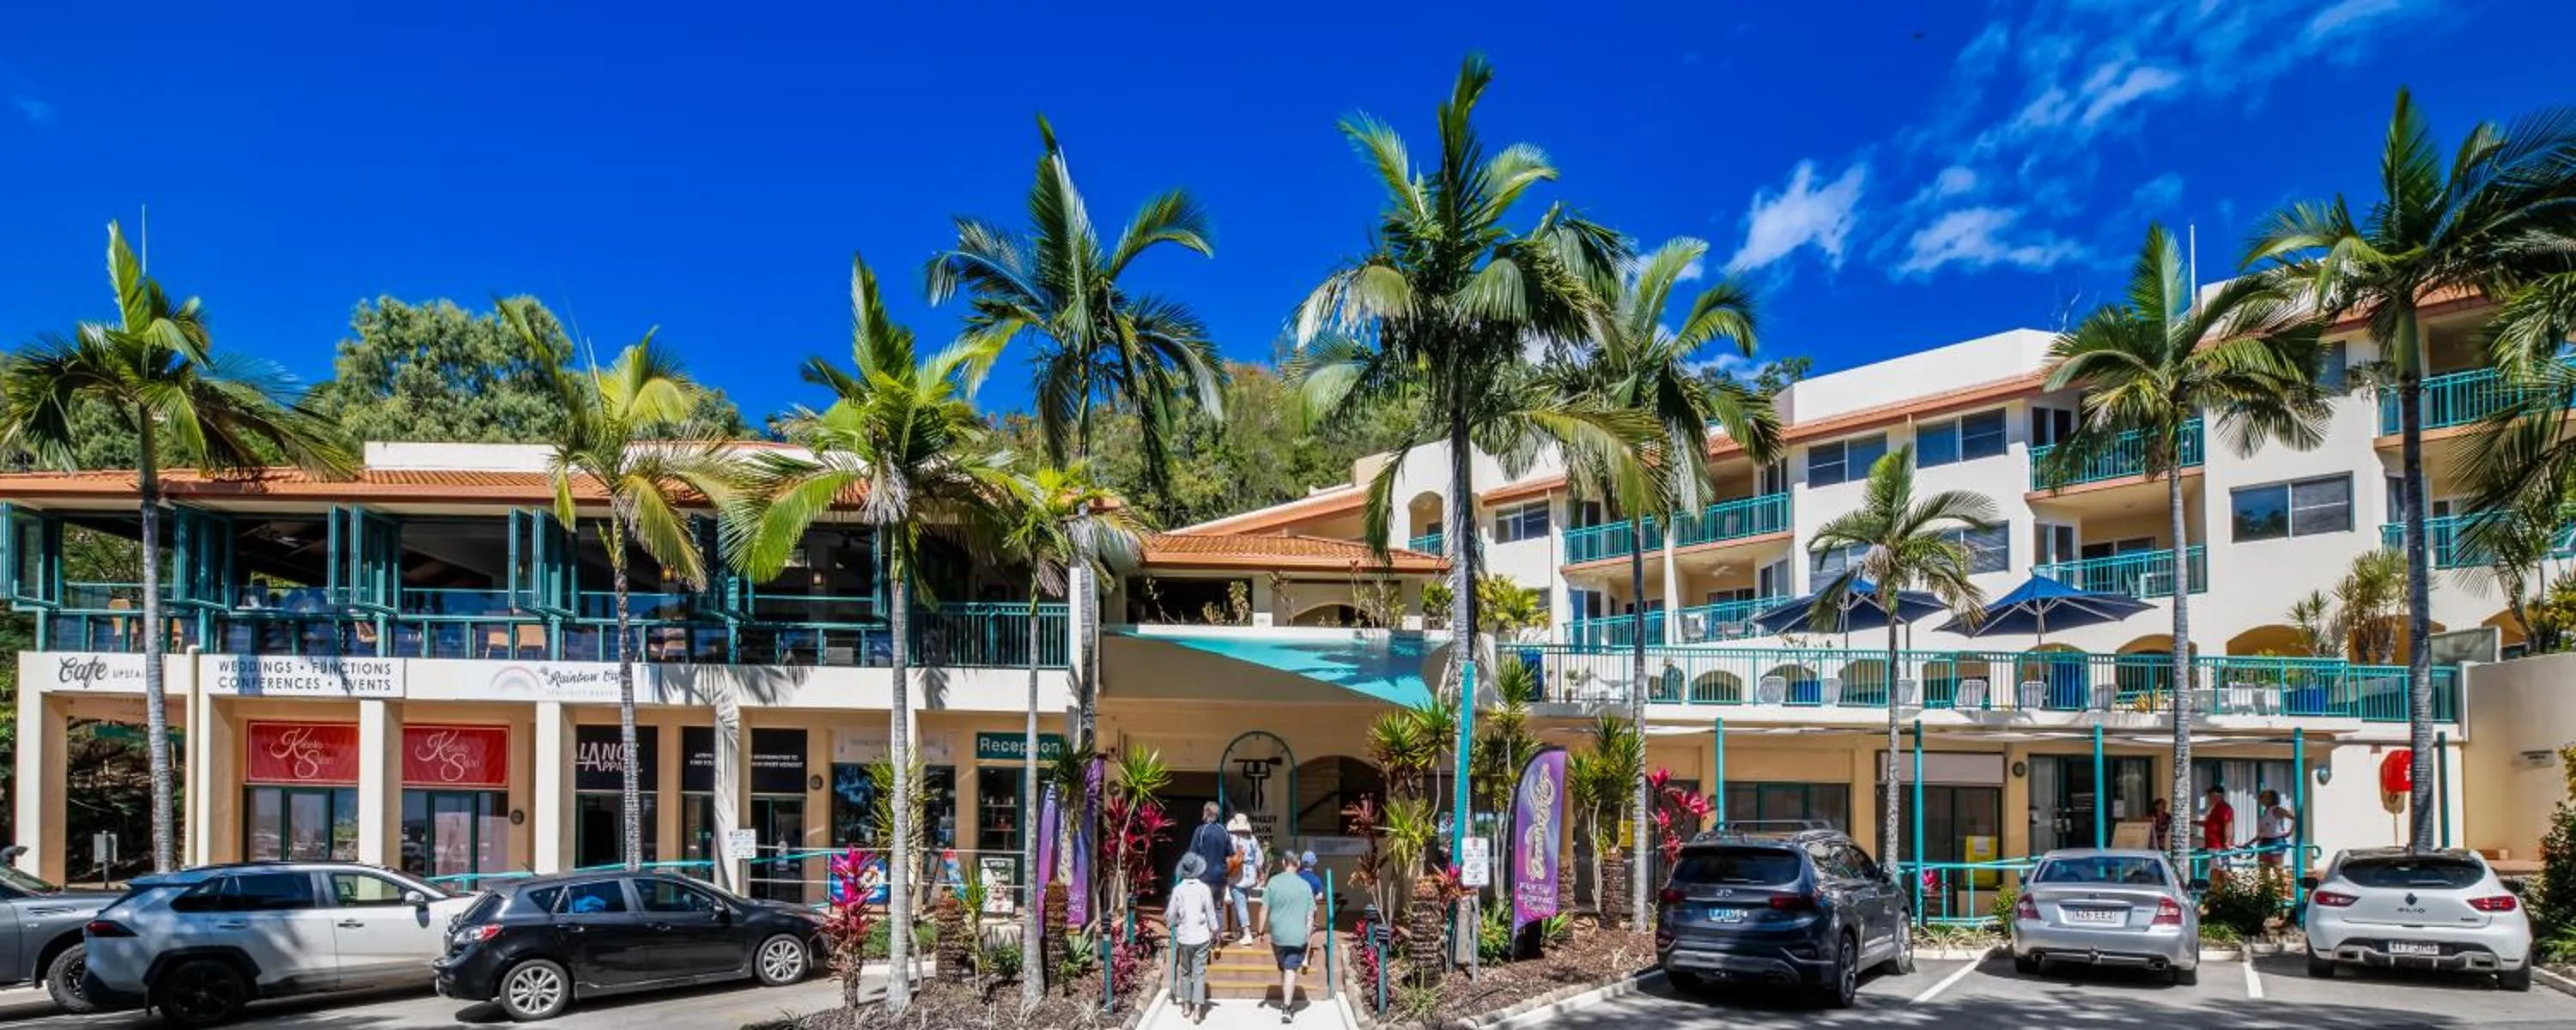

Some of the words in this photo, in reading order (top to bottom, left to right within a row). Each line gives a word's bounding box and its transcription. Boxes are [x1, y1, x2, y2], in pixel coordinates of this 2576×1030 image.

[59, 656, 106, 688] Cafe
[112, 669, 144, 679] UPSTAI
[218, 661, 293, 674] WEDDINGS
[312, 662, 392, 675] FUNCTIONS
[217, 676, 320, 689] CONFERENCES
[342, 678, 392, 691] EVENTS
[547, 669, 598, 688] Rainbow
[979, 737, 1060, 755] Recepion
